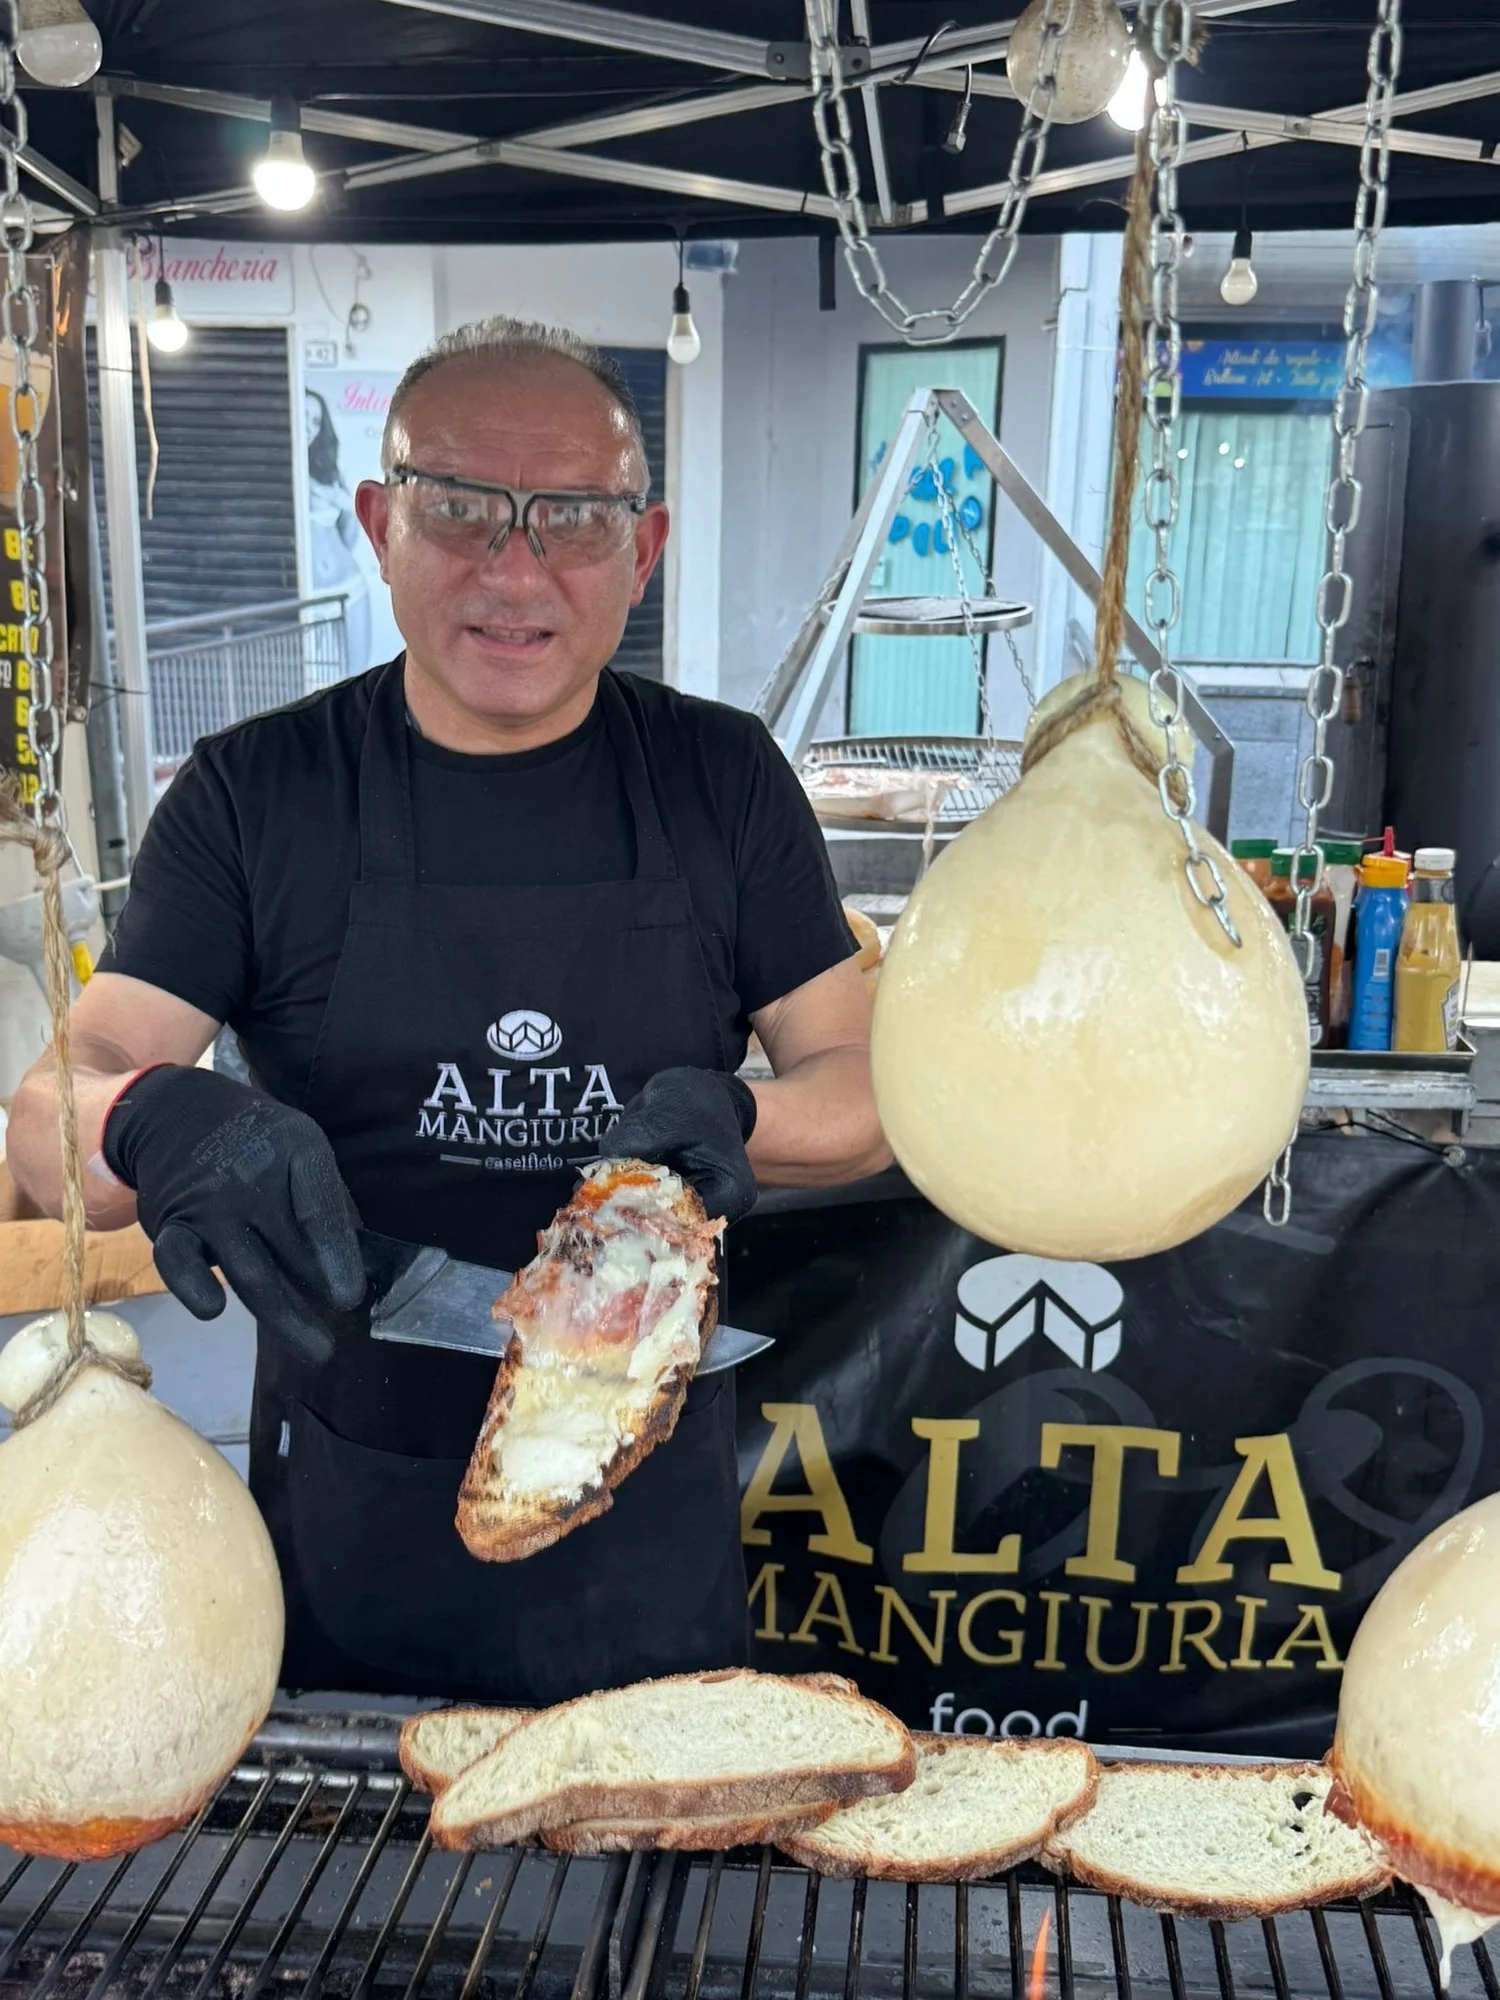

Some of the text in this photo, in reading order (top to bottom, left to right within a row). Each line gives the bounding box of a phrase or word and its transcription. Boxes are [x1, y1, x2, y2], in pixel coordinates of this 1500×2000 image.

[424, 1063, 625, 1116] ALTA
[741, 1403, 1342, 1591] ALTA
[929, 1692, 1089, 1738] food
